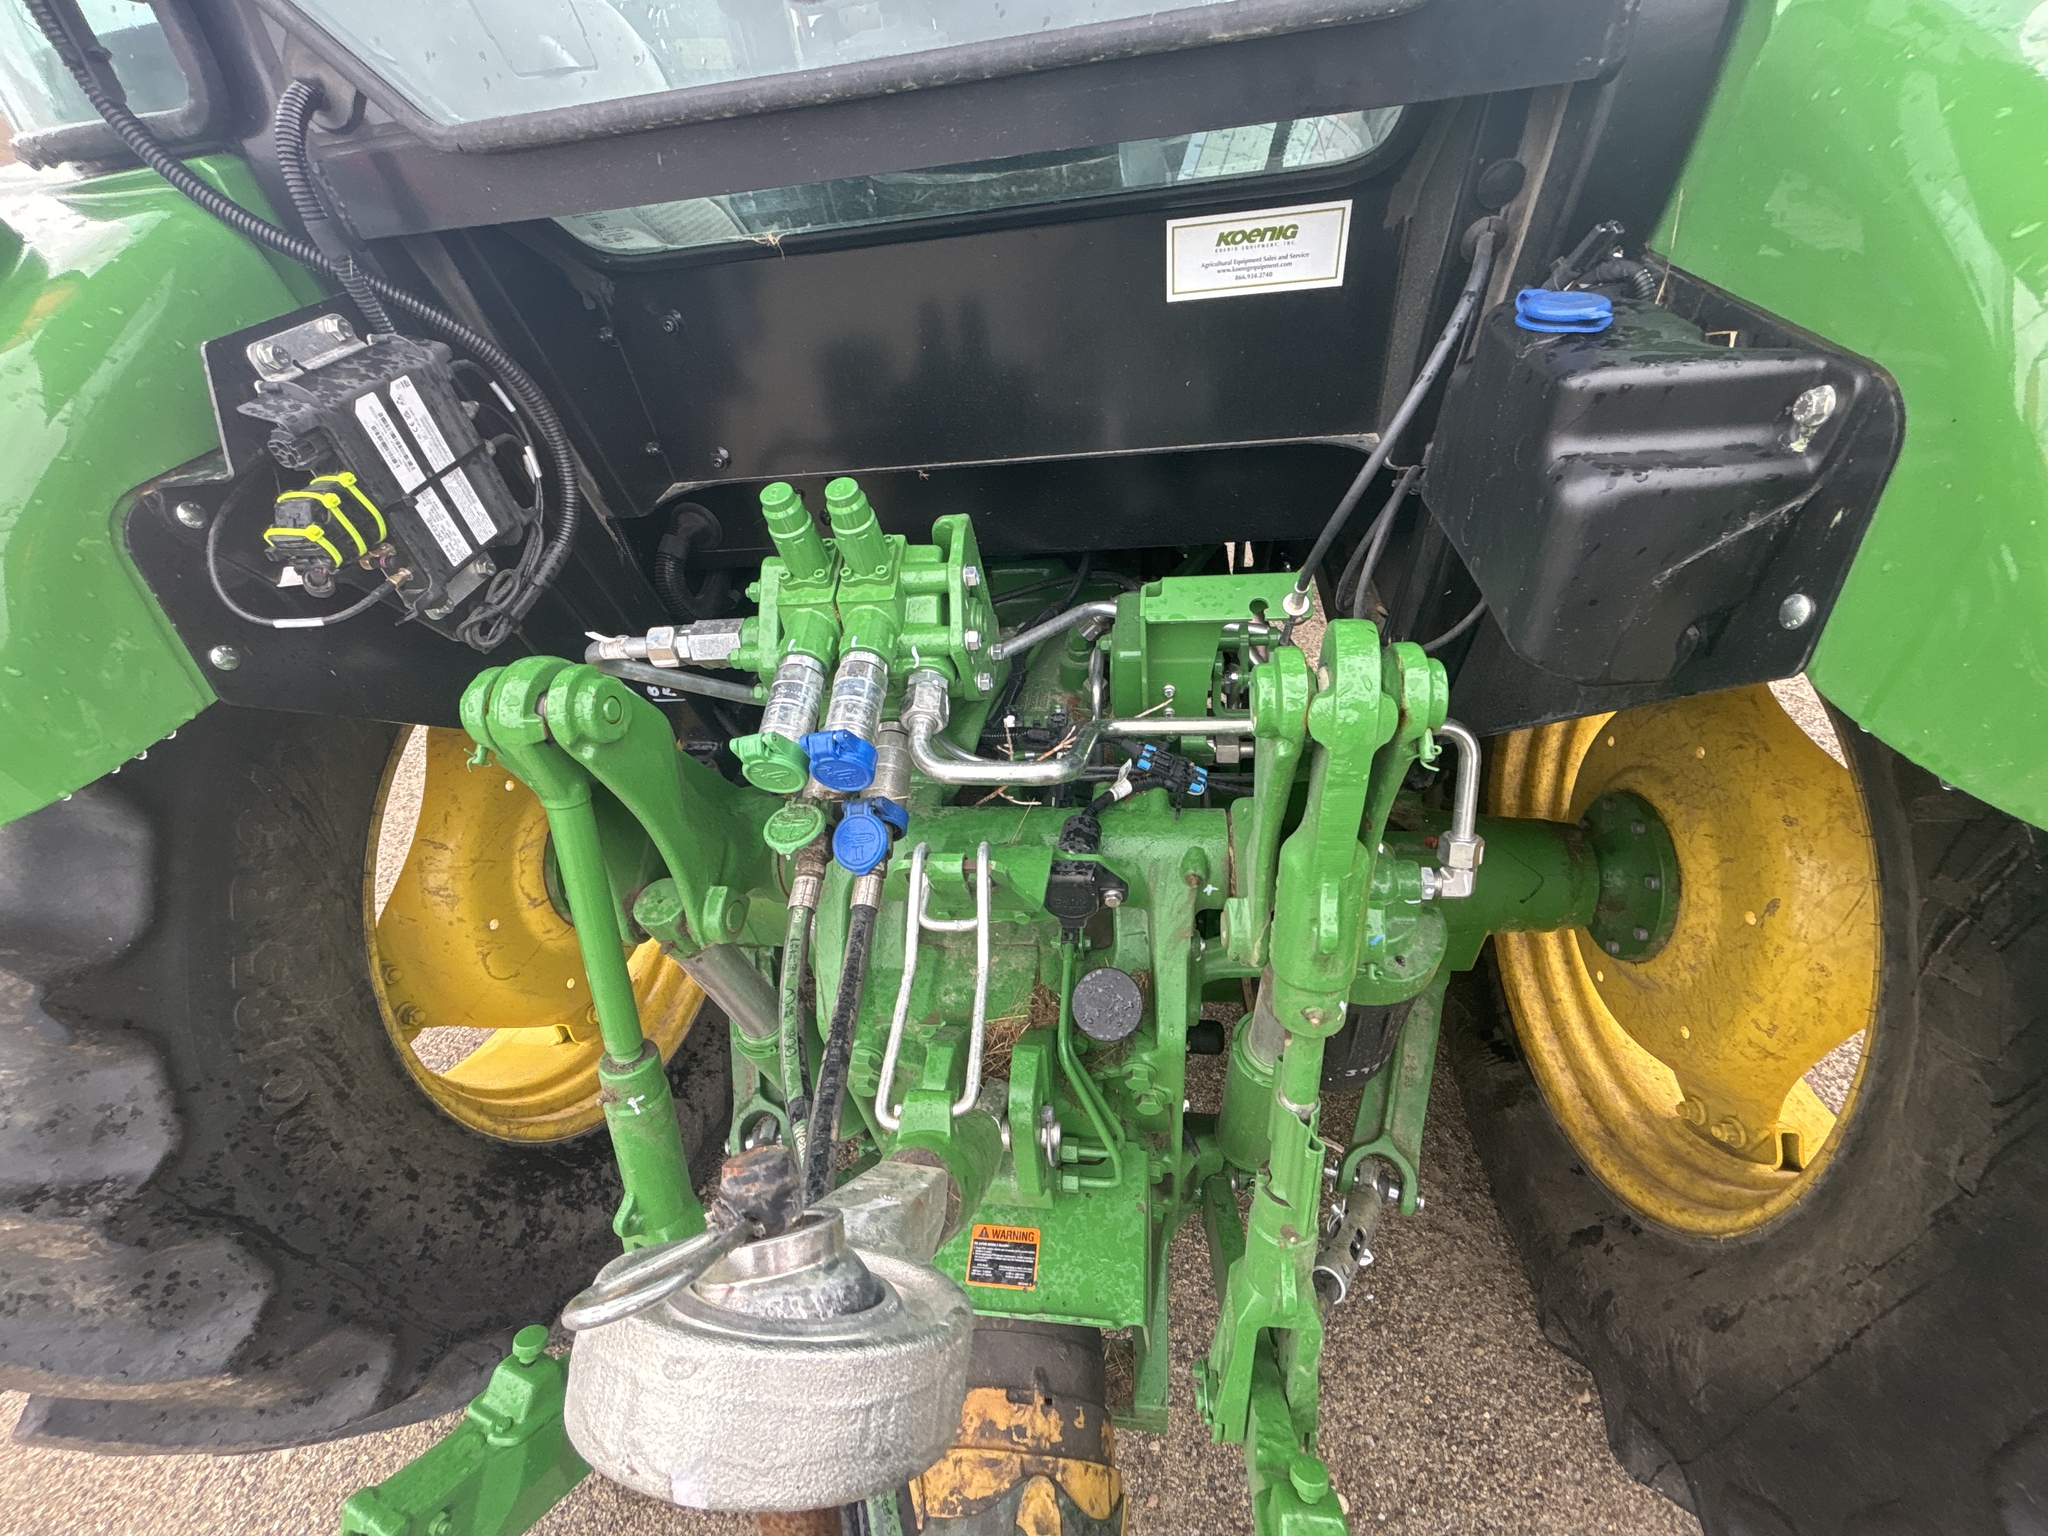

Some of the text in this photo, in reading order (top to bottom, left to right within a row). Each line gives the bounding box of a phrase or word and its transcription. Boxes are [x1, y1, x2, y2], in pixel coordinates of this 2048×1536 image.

[1200, 251, 1310, 270] Agricultural Equipment Sales and Service
[1216, 261, 1293, 273] www.koenigequipment.com
[1234, 271, 1273, 281] 866.934.2740
[426, 517, 460, 564] JOHN DEERE
[991, 1228, 1036, 1243] WARNING
